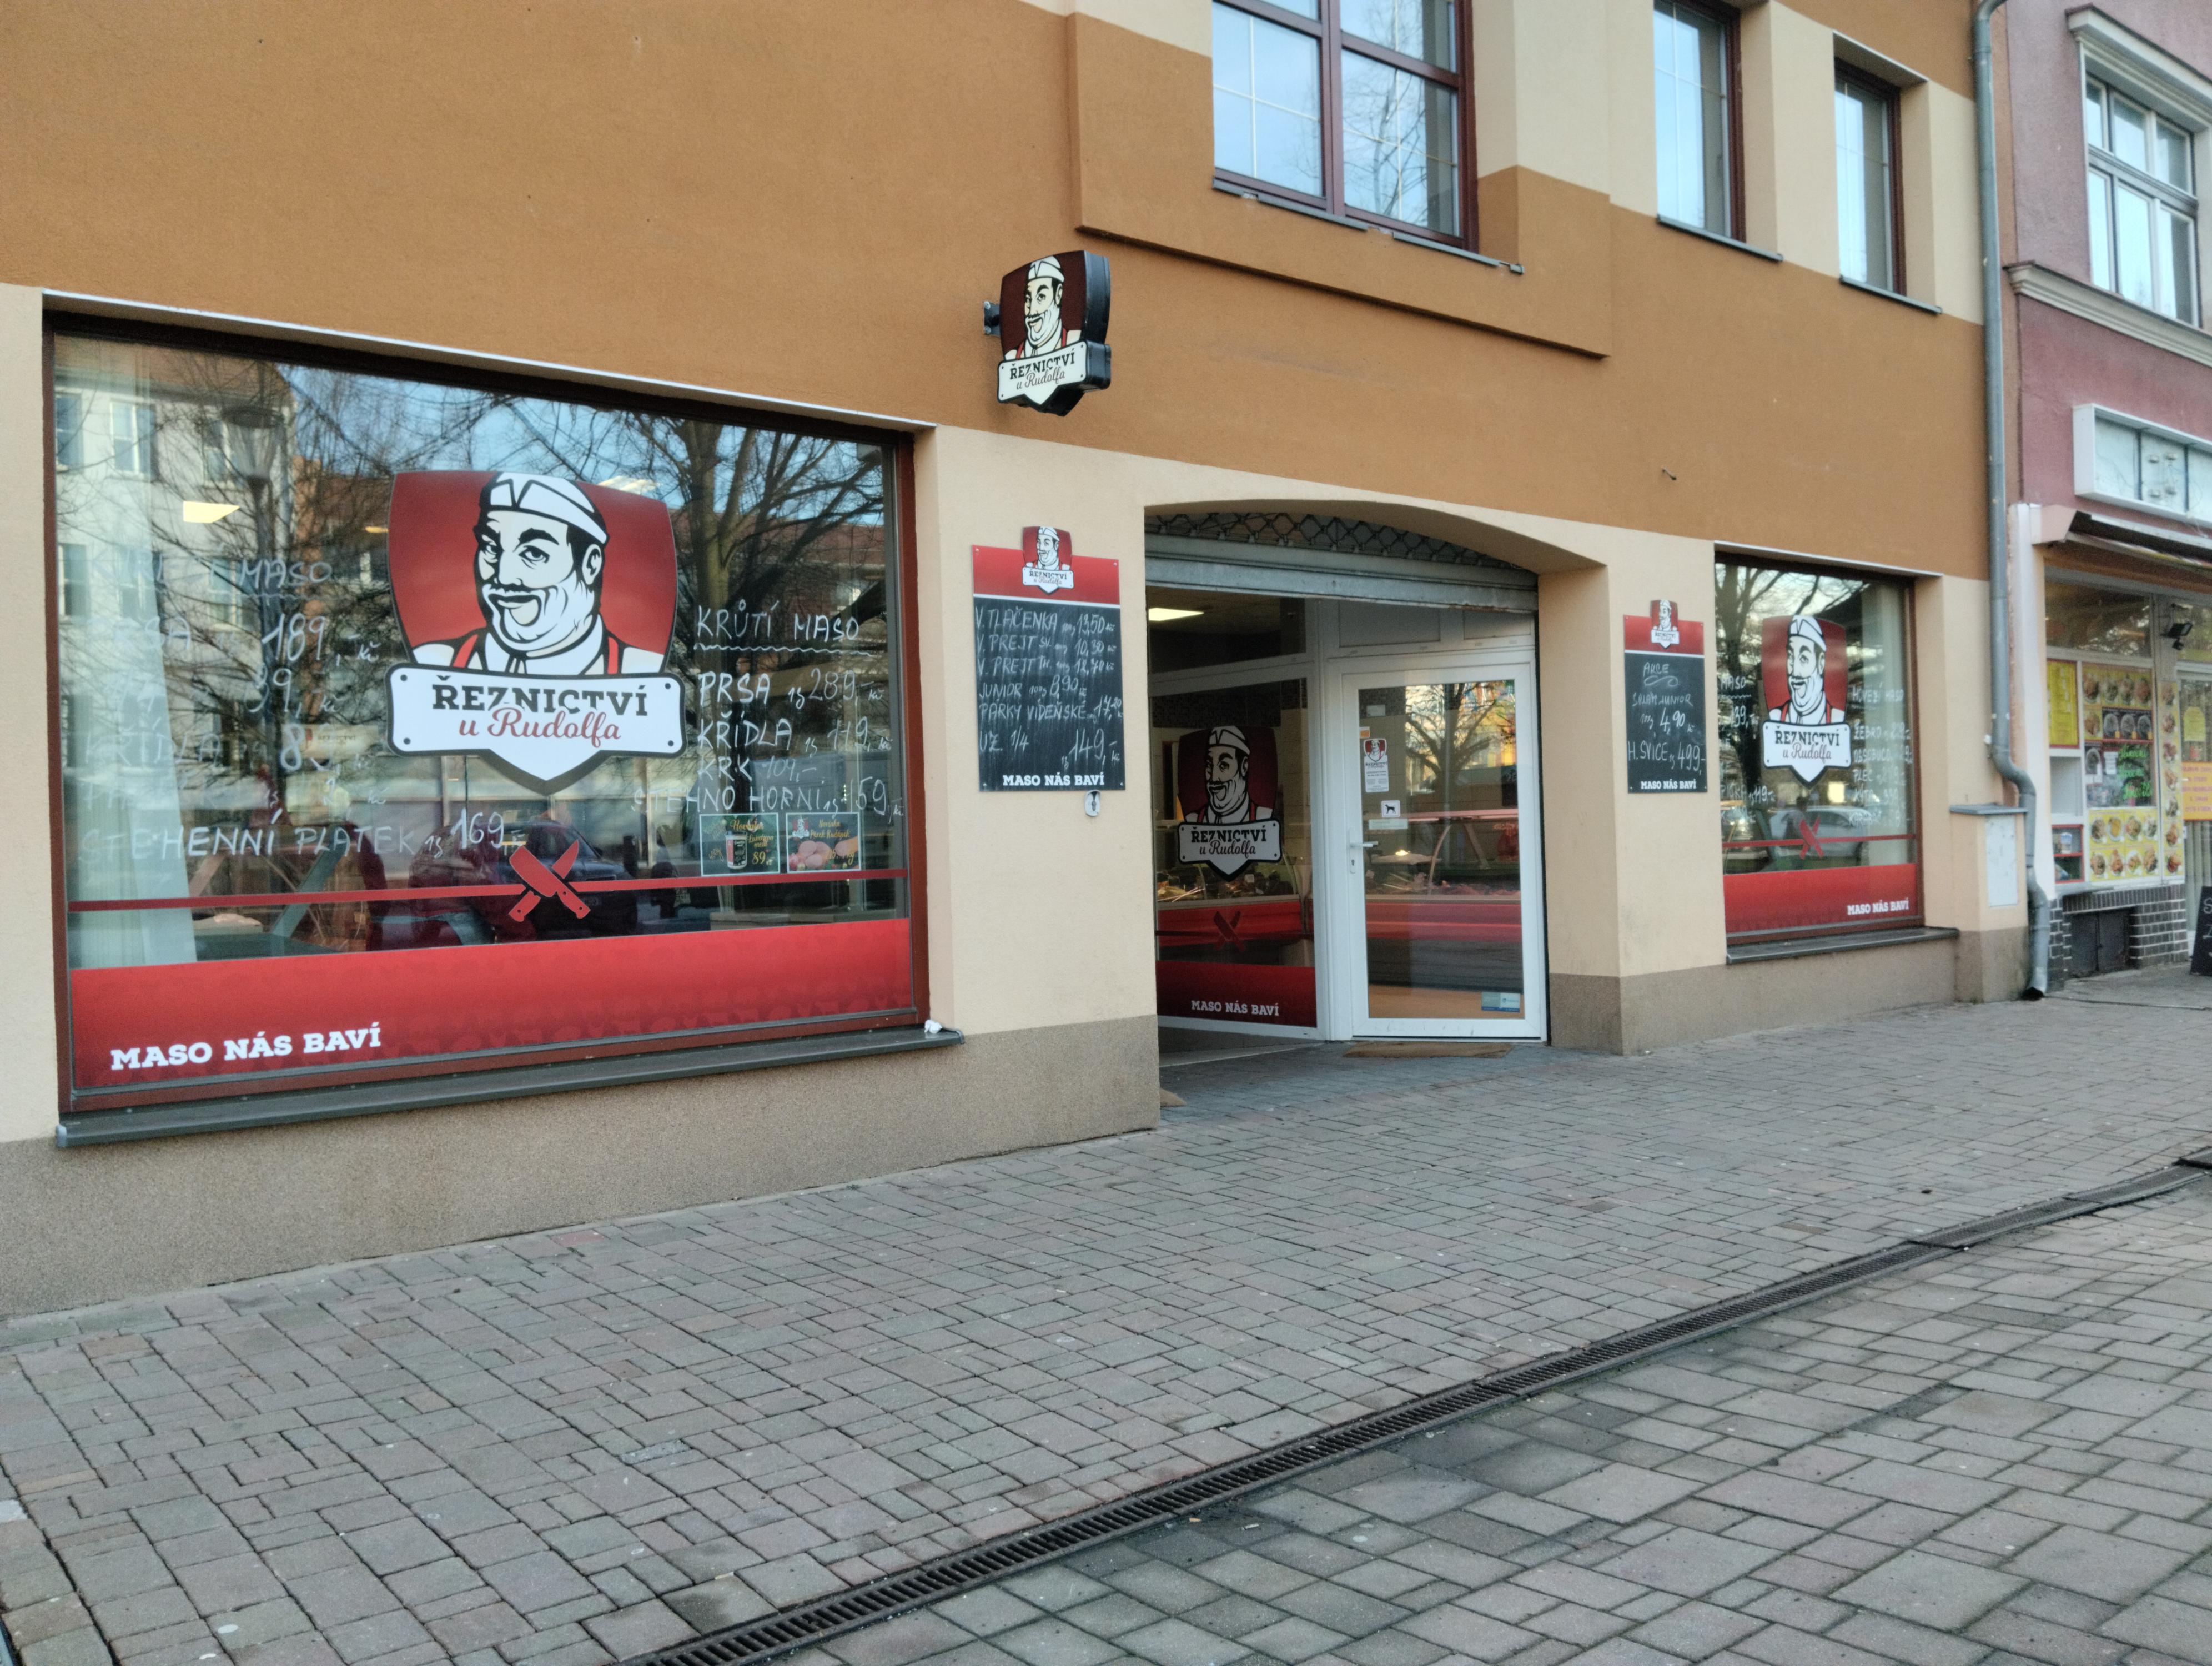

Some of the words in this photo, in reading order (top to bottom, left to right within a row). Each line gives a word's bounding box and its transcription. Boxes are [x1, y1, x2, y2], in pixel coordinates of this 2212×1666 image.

[1009, 348, 1075, 380] ŘEZNICTVÍ
[1017, 381, 1022, 389] u
[1024, 367, 1065, 388] Rudolfa
[240, 558, 332, 589] MASO
[1029, 569, 1067, 579] ŘEZNICTVÍ
[697, 599, 780, 640] KRŮTÍ
[794, 613, 859, 643] MASO
[987, 606, 1058, 633] TLAČENKA
[1643, 662, 1670, 677] AKCE
[431, 675, 648, 717] ŘEZNICTVÍ
[698, 672, 771, 708] PRSA
[979, 683, 1023, 698] JUNIOR
[979, 697, 1022, 721] PÁRKY
[459, 718, 479, 737] u
[487, 706, 621, 749] Rudolfa
[697, 711, 792, 751] KŘÍDLA
[1775, 725, 1841, 746] ŘEZNICTVÍ
[1783, 749, 1789, 759] u
[1791, 742, 1832, 764] Rudolfa
[697, 756, 753, 781] KRK
[1003, 775, 1041, 786] MASO
[1044, 772, 1071, 786] NÁS
[1074, 772, 1104, 786] BAVÍ
[1641, 781, 1662, 790] MASO
[1663, 779, 1678, 789] NÁS
[1680, 779, 1697, 789] BAVÍ
[631, 785, 736, 814] STEHNO
[1190, 825, 1266, 843] ŘEZNICTVÍ
[1199, 846, 1206, 855] u
[1209, 840, 1256, 859] Rudolfa
[1847, 904, 1871, 915] MASO
[1873, 900, 1889, 914] NÁS
[1891, 897, 1909, 911] BAVÍ
[1191, 1000, 1221, 1012] MASO
[1225, 1000, 1248, 1014] NÁS
[1251, 1002, 1279, 1016] BAVÍ
[111, 1042, 212, 1070] MASO
[224, 1031, 293, 1061] NÁS
[303, 1022, 381, 1053] BAVÍ
